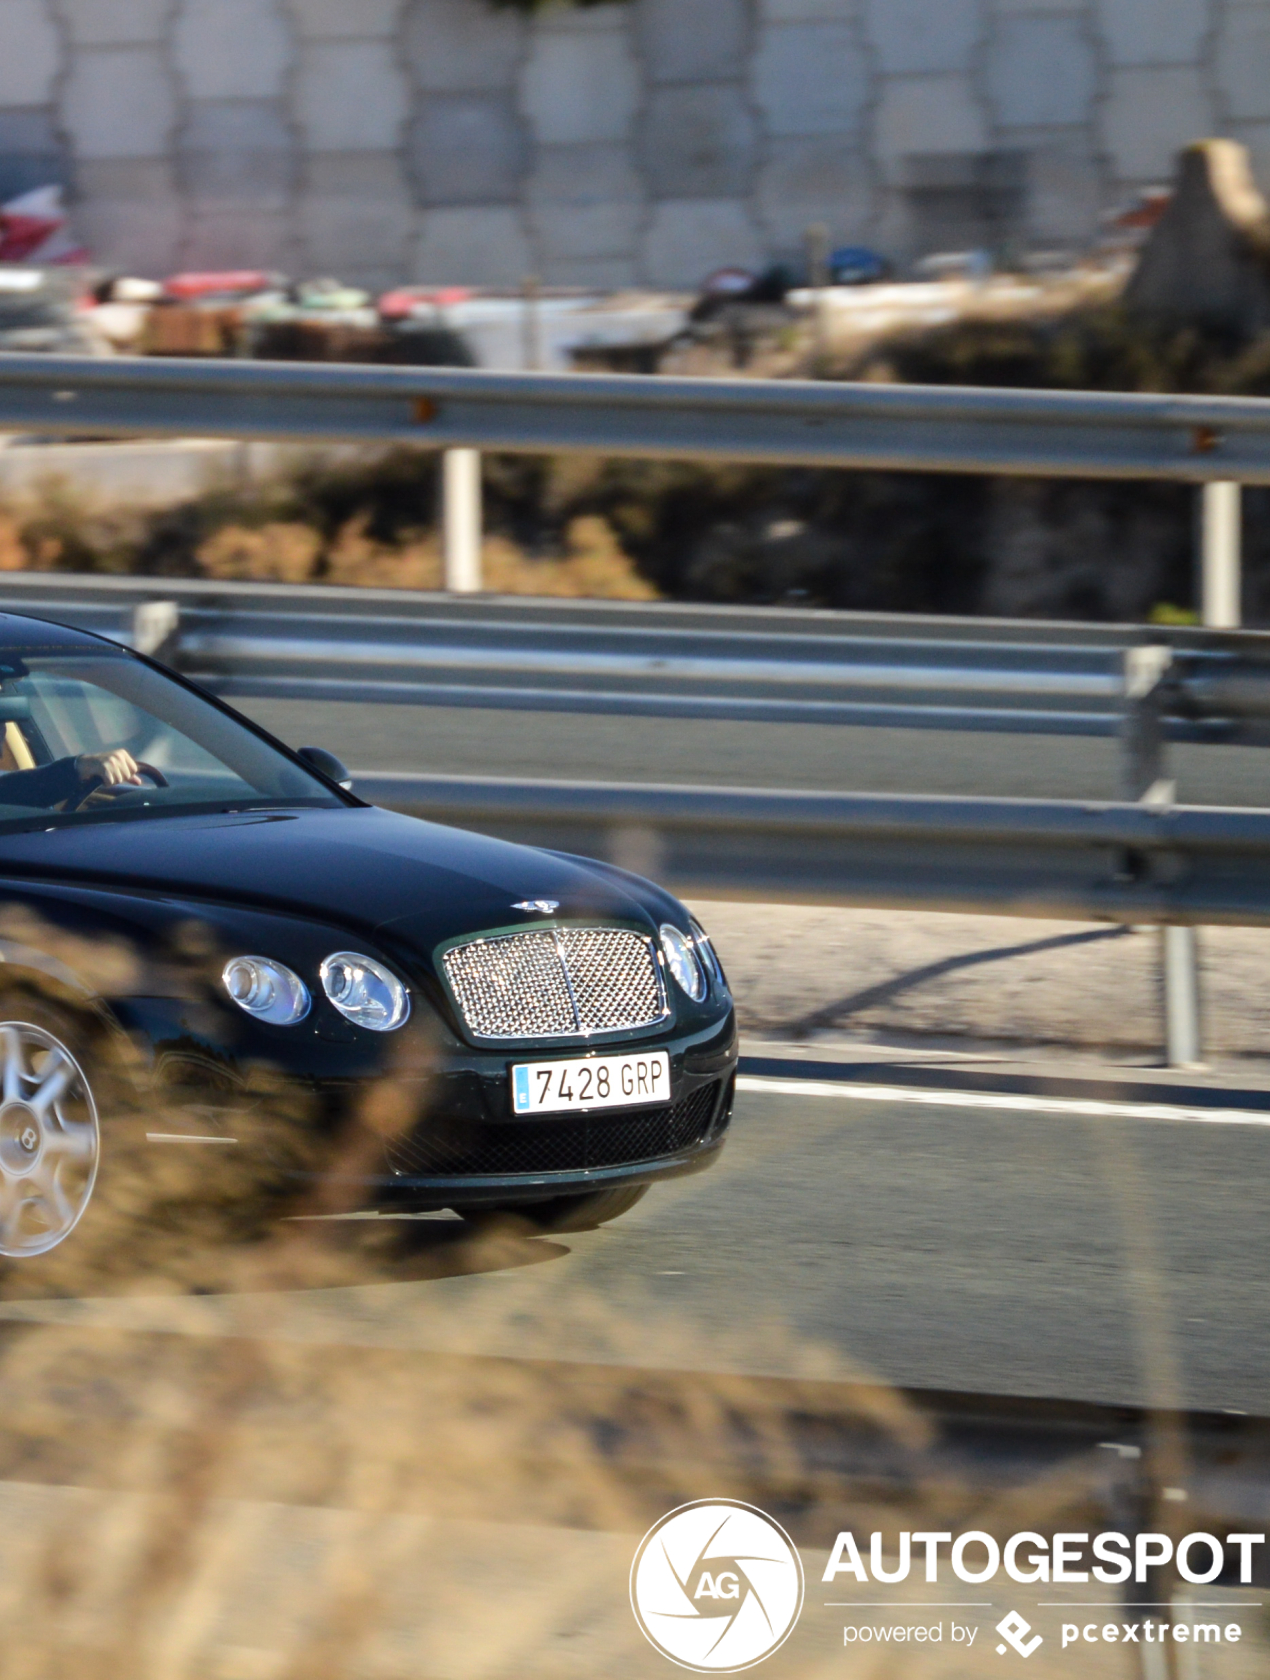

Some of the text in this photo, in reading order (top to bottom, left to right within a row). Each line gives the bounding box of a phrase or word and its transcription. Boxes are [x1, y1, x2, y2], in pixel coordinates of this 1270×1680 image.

[536, 1060, 663, 1104] 7428 GRP
[519, 1092, 527, 1104] E
